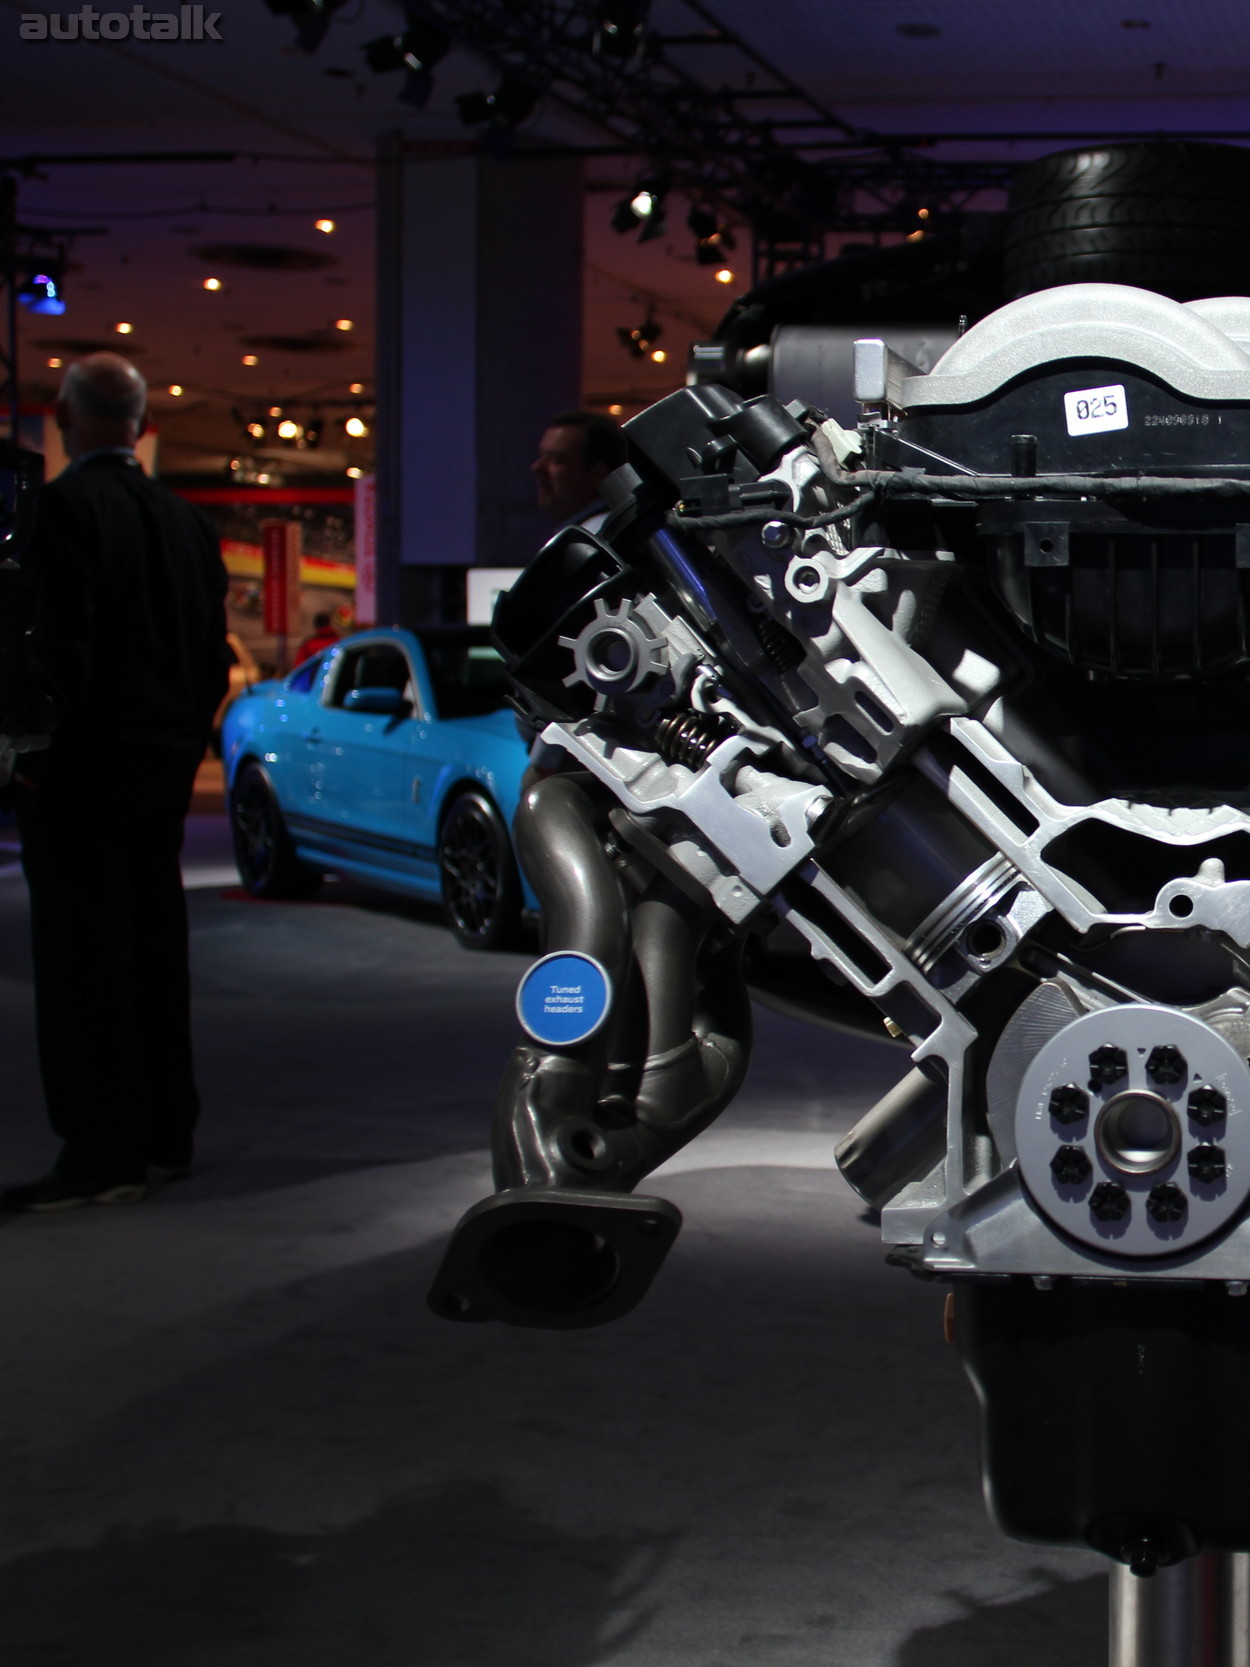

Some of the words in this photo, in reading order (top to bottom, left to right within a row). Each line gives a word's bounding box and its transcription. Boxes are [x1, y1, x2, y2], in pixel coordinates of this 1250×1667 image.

[1076, 395, 1117, 420] 025
[550, 985, 582, 994] Tuned
[544, 995, 584, 1004] exhaust
[544, 1004, 584, 1013] headers
